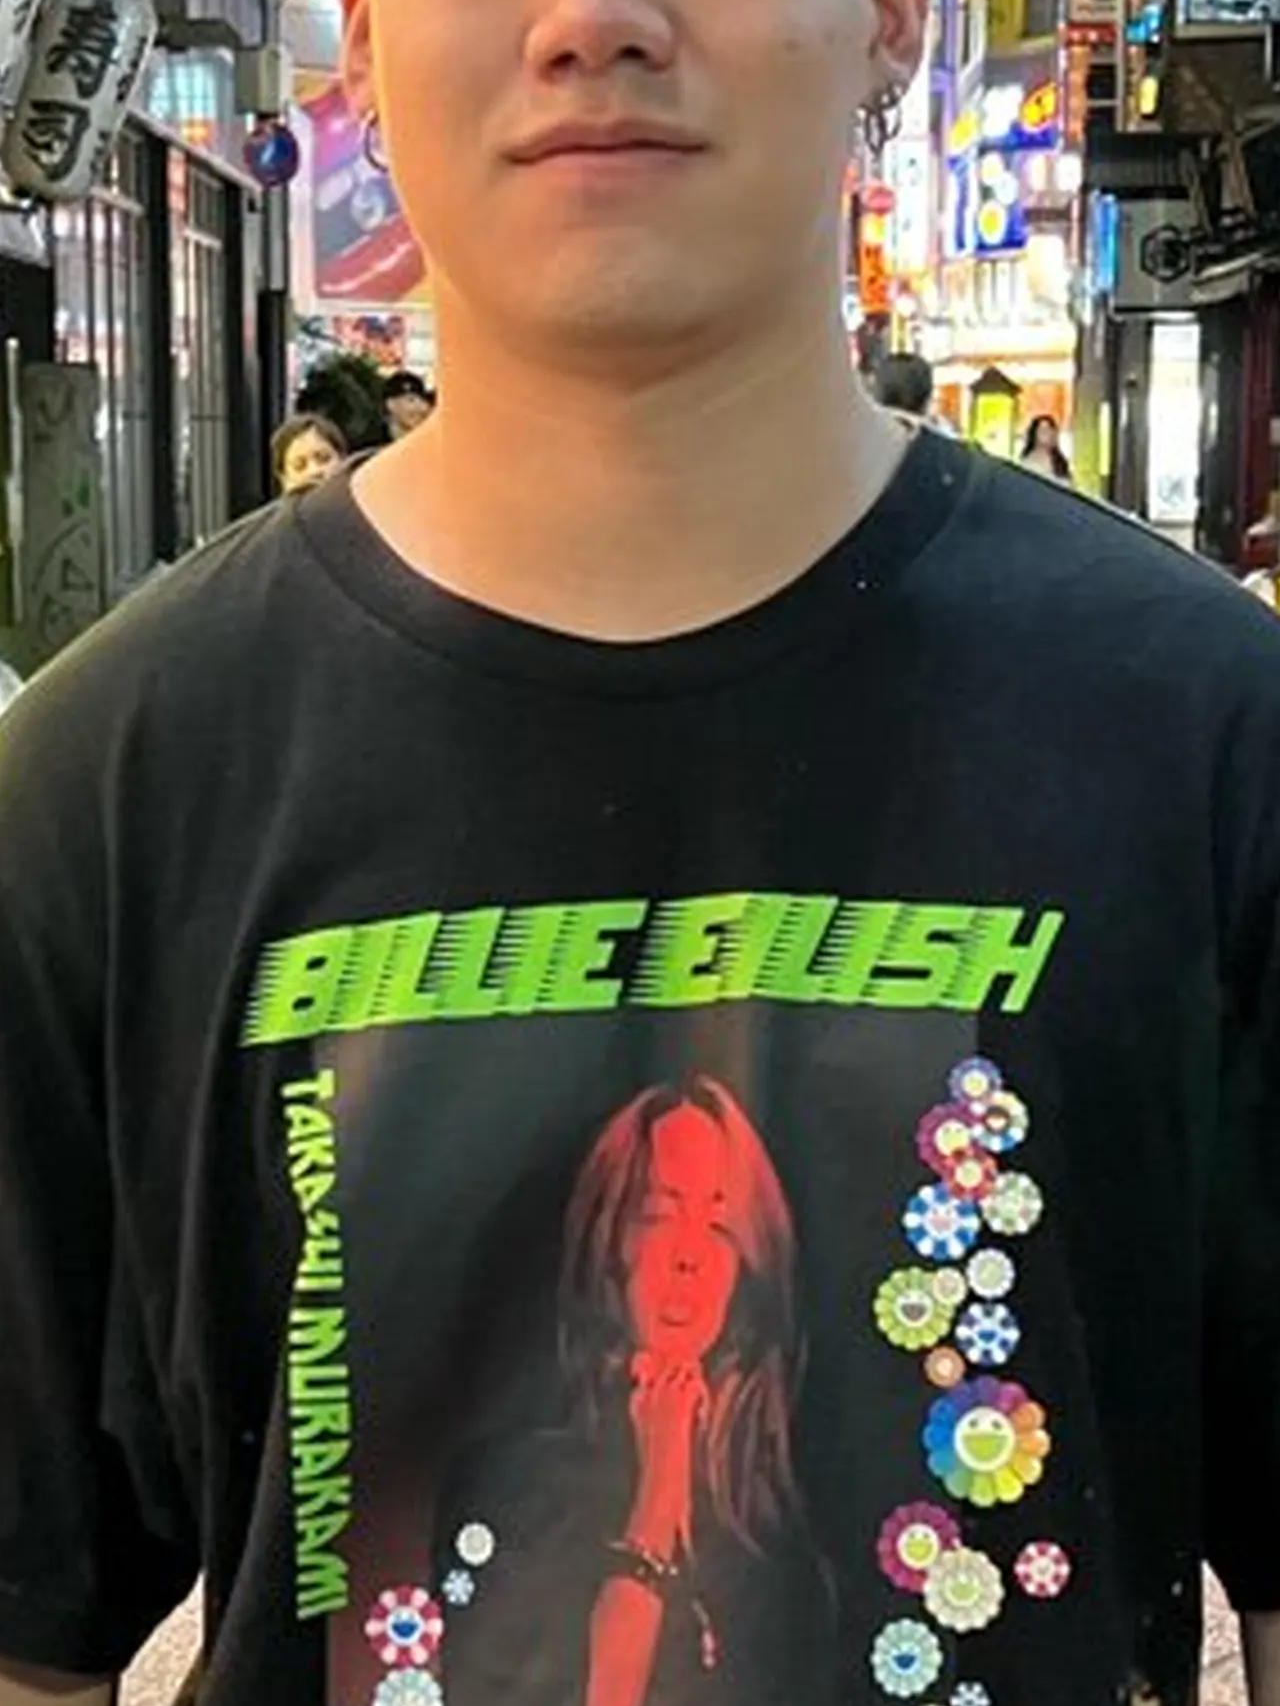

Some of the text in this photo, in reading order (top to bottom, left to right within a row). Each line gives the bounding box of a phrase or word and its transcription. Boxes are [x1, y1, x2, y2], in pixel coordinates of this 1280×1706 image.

[241, 890, 1065, 1049] BILLIE EILISH
[281, 1067, 353, 1621] TAKASHI MURAKAMI
